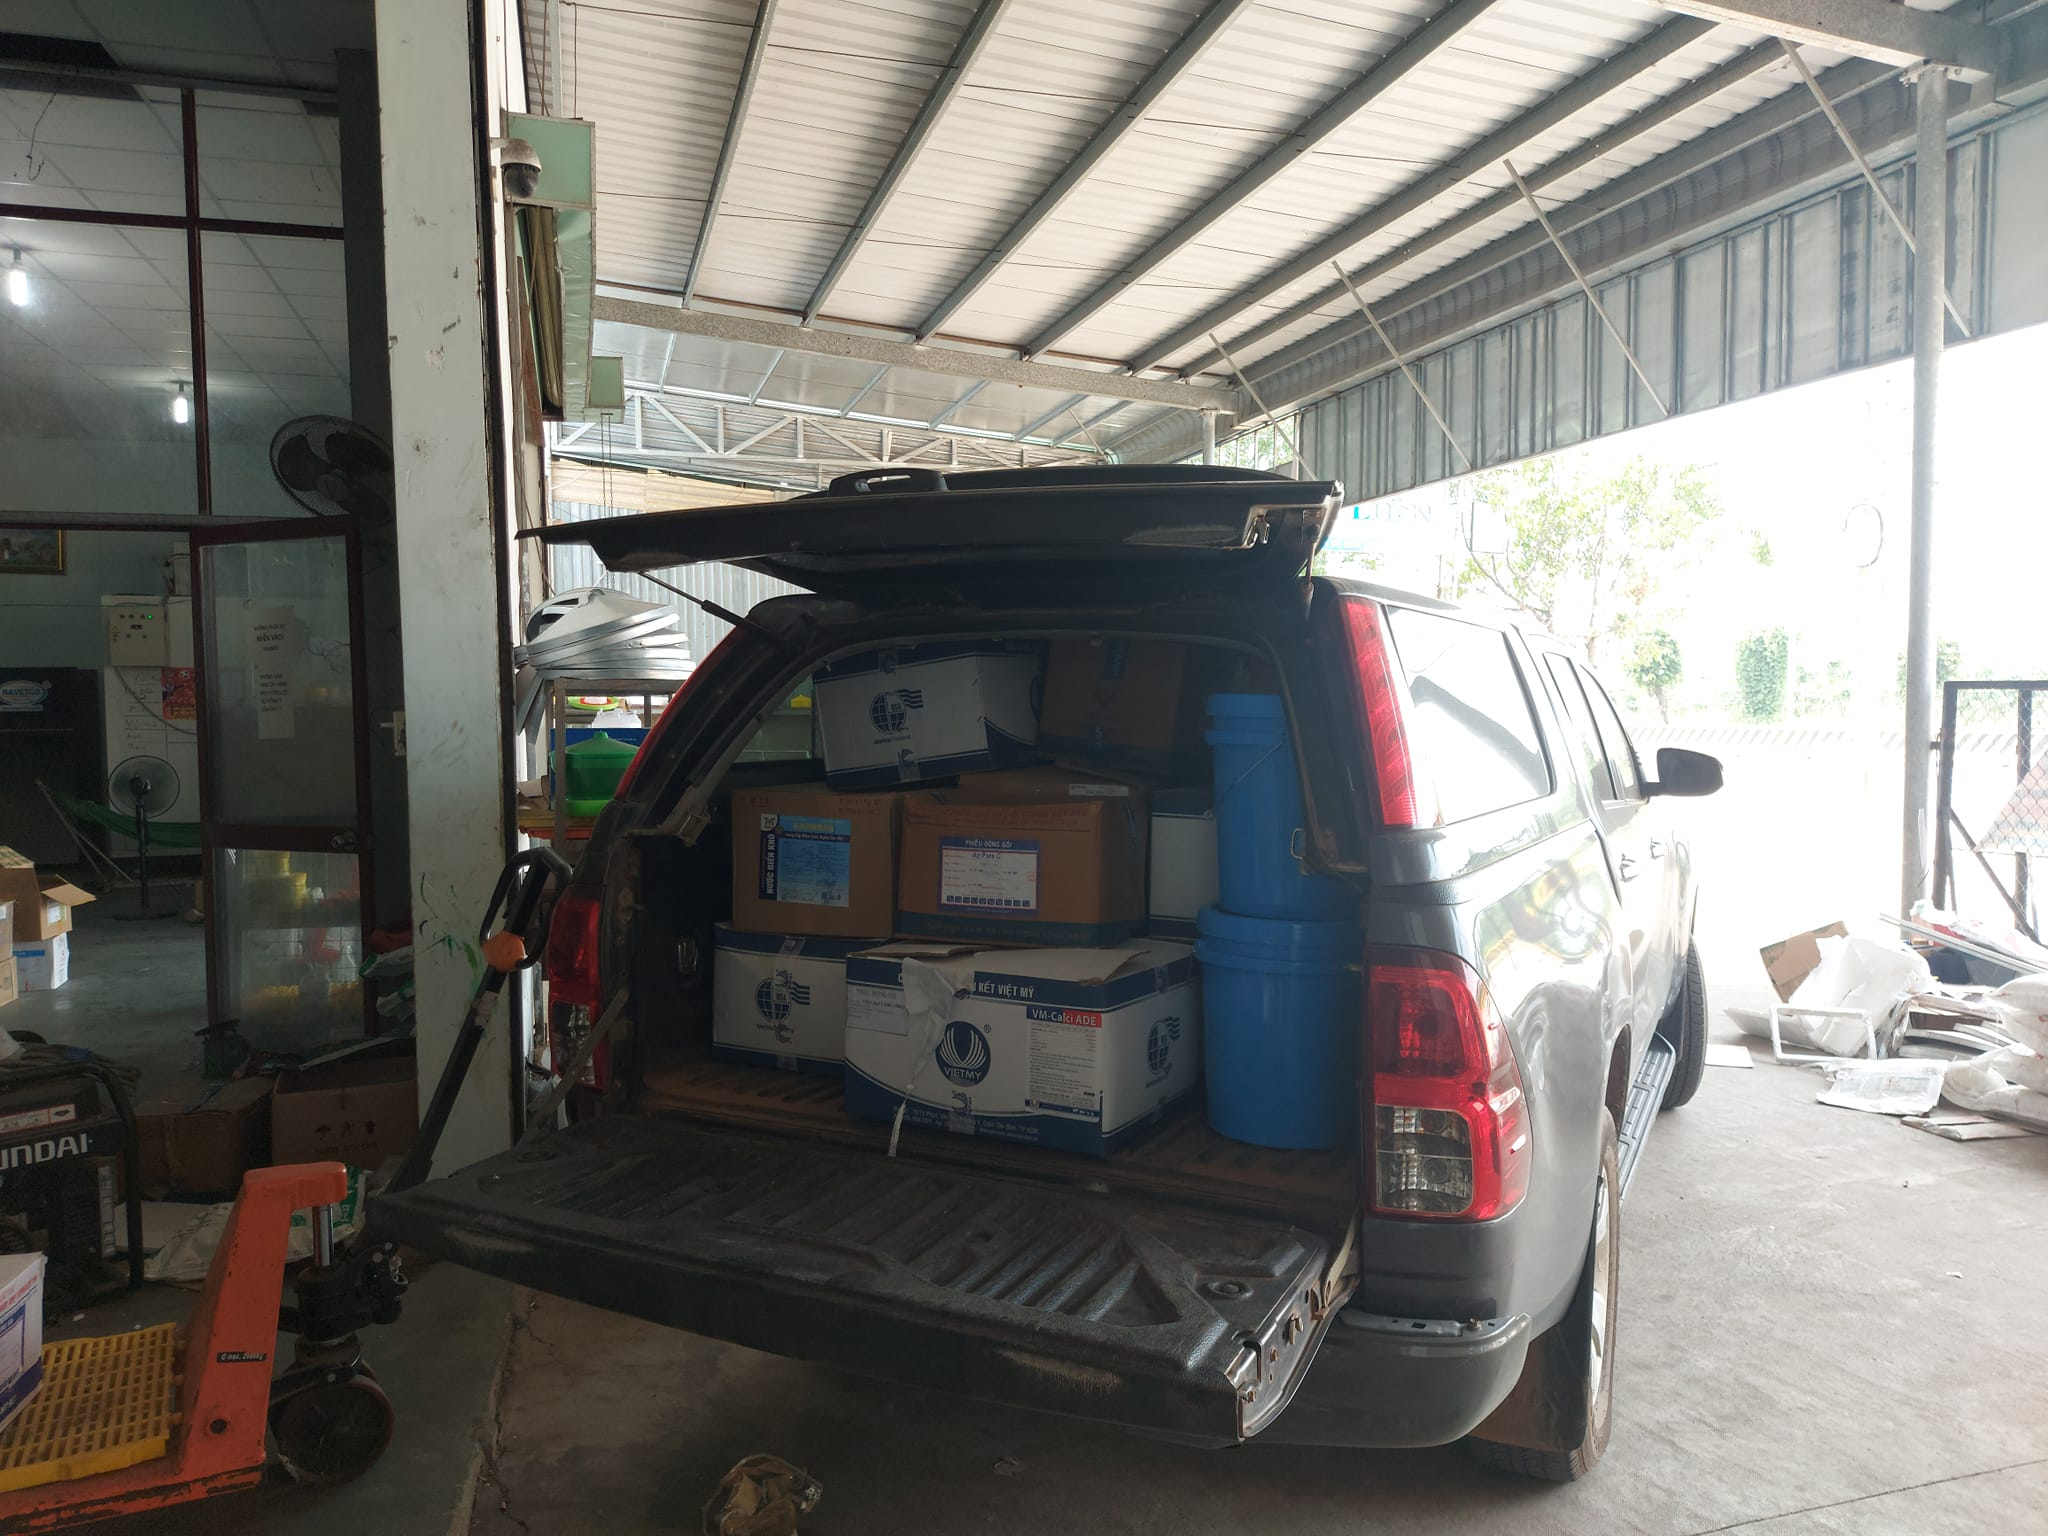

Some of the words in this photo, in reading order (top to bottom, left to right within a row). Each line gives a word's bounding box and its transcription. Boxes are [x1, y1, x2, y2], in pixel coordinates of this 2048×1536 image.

[978, 979, 995, 994] KẾT
[997, 983, 1018, 998] VIỆT
[1019, 984, 1035, 999] MỸ
[1032, 1008, 1073, 1024] VM-Calci
[1075, 1015, 1097, 1026] ADE
[944, 1067, 982, 1080] VIETMY
